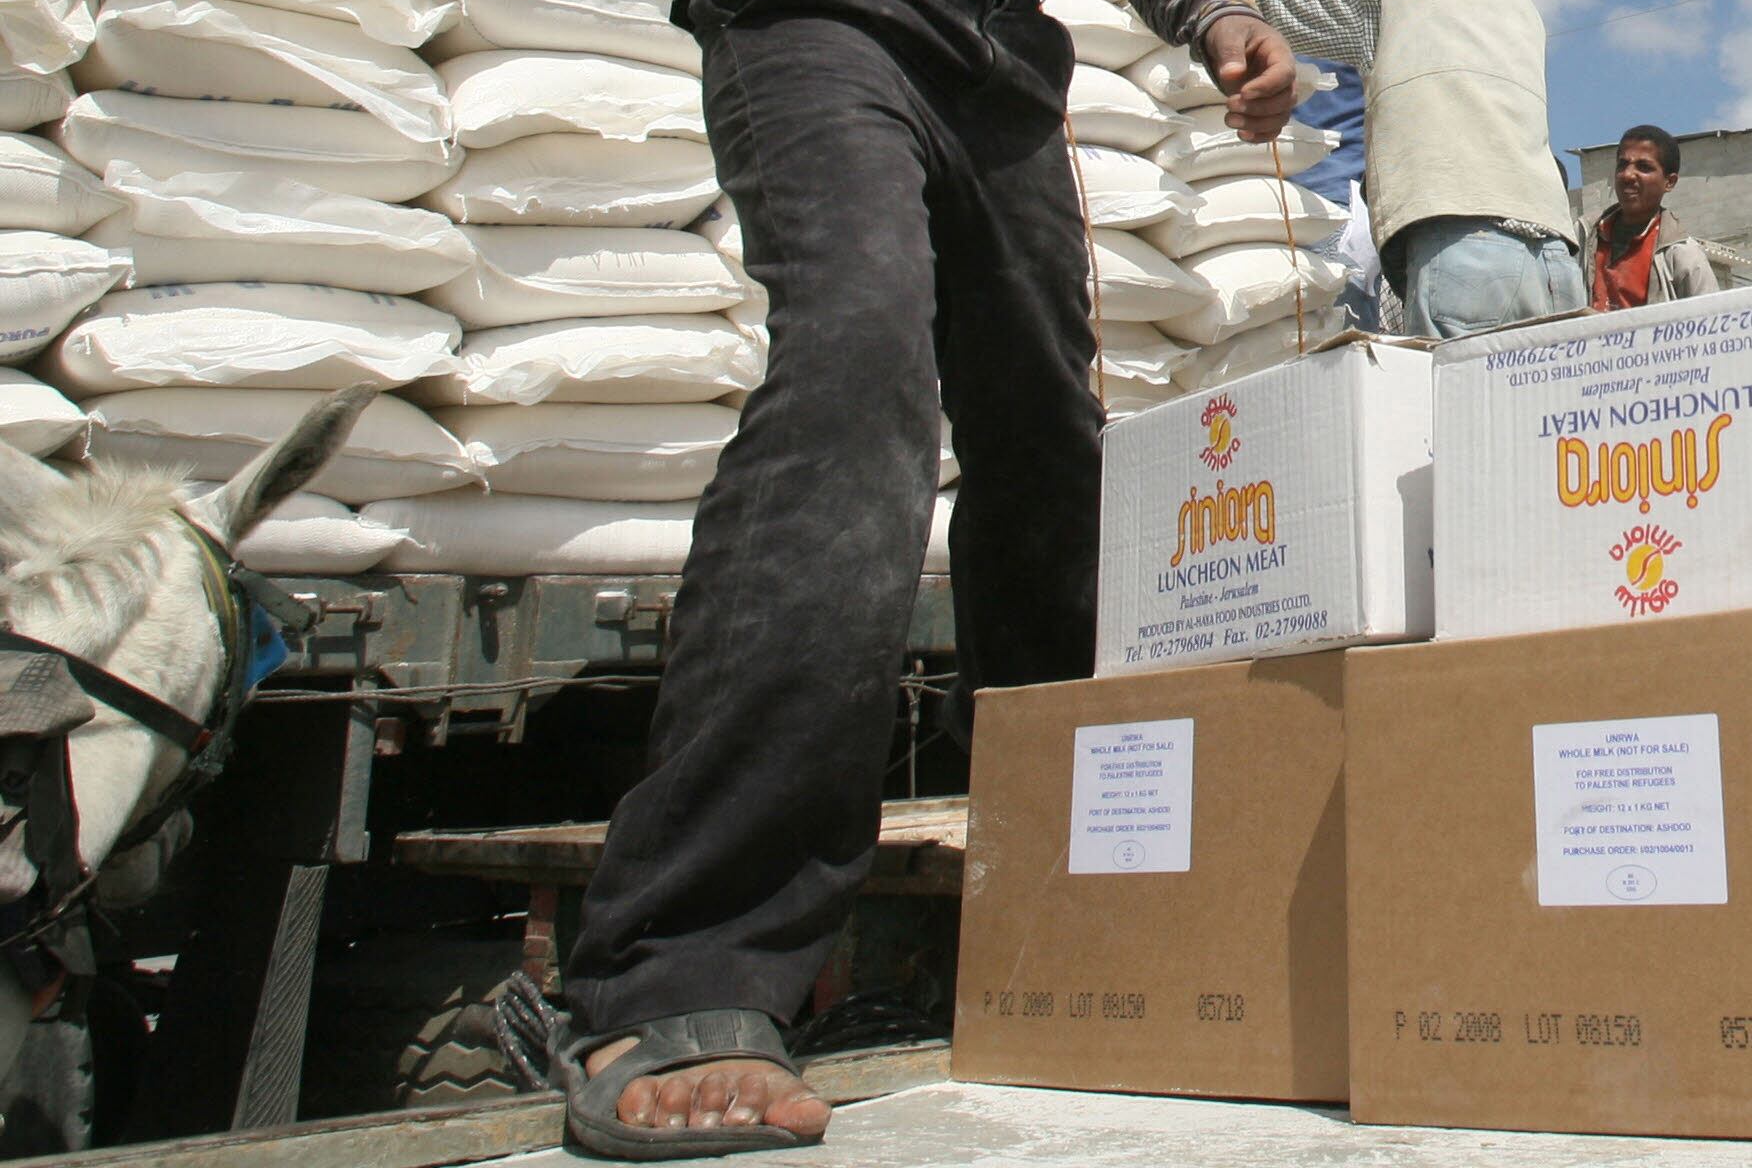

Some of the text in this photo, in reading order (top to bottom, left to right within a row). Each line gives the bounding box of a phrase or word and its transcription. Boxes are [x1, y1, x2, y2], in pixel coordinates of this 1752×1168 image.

[1597, 328, 1637, 350] Fax.
[1701, 342, 1718, 357] BY
[1485, 337, 1587, 372] 02-2799088
[1616, 350, 1649, 370] FOOD
[1651, 343, 1698, 364] AL-HAYA
[1550, 356, 1613, 381] INDUSTRIES
[1654, 366, 1711, 392] Palestine
[1581, 374, 1643, 399] Jerusalem
[1538, 407, 1602, 438] MEAT
[1157, 544, 1288, 594] LUNCHEON MEAT
[1180, 590, 1213, 610] Palestine
[1219, 583, 1259, 605] Jerusalem
[1138, 619, 1174, 639] PRODUCED
[1216, 608, 1237, 625] FOOD
[1238, 600, 1280, 622] INDUSTRIES
[1125, 610, 1328, 663] Tel. 02-2796804 Fax. 02-2799088
[1605, 733, 1640, 744] UNRWA
[1558, 742, 1690, 759] WHOLE MILK (NOT FOR SALE)
[1574, 777, 1676, 791] TO PALESTINE REFUGEES
[1576, 766, 1673, 779] FOR FREE DISTRIBUTION
[1617, 803, 1626, 813] 12
[1640, 802, 1652, 812] KG
[1654, 802, 1670, 811] NET
[1586, 825, 1598, 834] OF
[1656, 822, 1691, 833] ASHDOD
[1563, 845, 1606, 856] PURCHASE
[1068, 992, 1094, 1019] LOT
[1197, 993, 1245, 1022] 05718
[1418, 1011, 1443, 1042] 02
[1454, 1011, 1502, 1043] 2008
[1524, 1013, 1563, 1045] LOT
[1575, 1013, 1642, 1047] 08150
